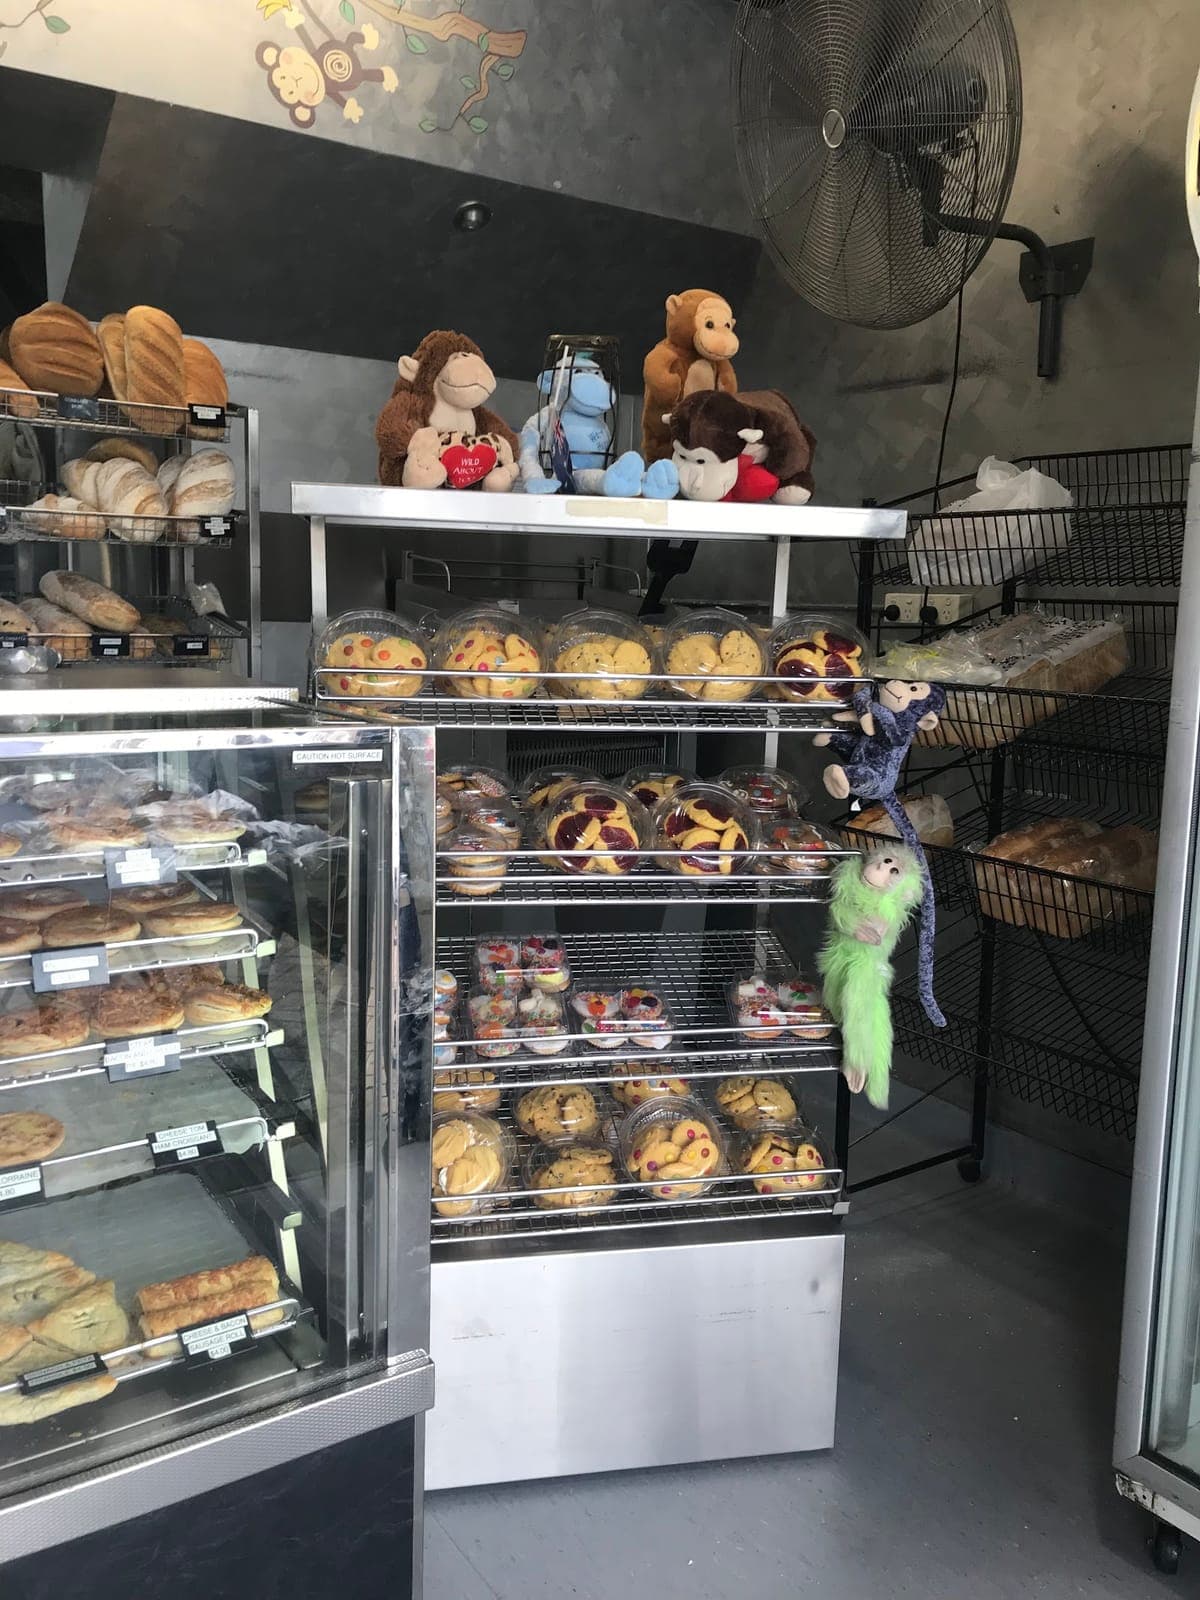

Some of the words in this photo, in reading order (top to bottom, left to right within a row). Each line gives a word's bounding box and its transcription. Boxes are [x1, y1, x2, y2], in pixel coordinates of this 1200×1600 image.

[461, 457, 480, 466] WILD
[296, 752, 329, 761] CAUTION
[331, 752, 345, 761] HOT
[348, 751, 381, 760] SURFACE
[158, 1129, 188, 1139] CHEESE
[189, 1125, 204, 1133] TOM
[155, 1142, 171, 1150] HAM
[183, 1327, 212, 1342] CHEESE
[221, 1317, 246, 1329] BACON
[190, 1336, 225, 1351] SAUSAGE
[226, 1329, 244, 1341] ROLL
